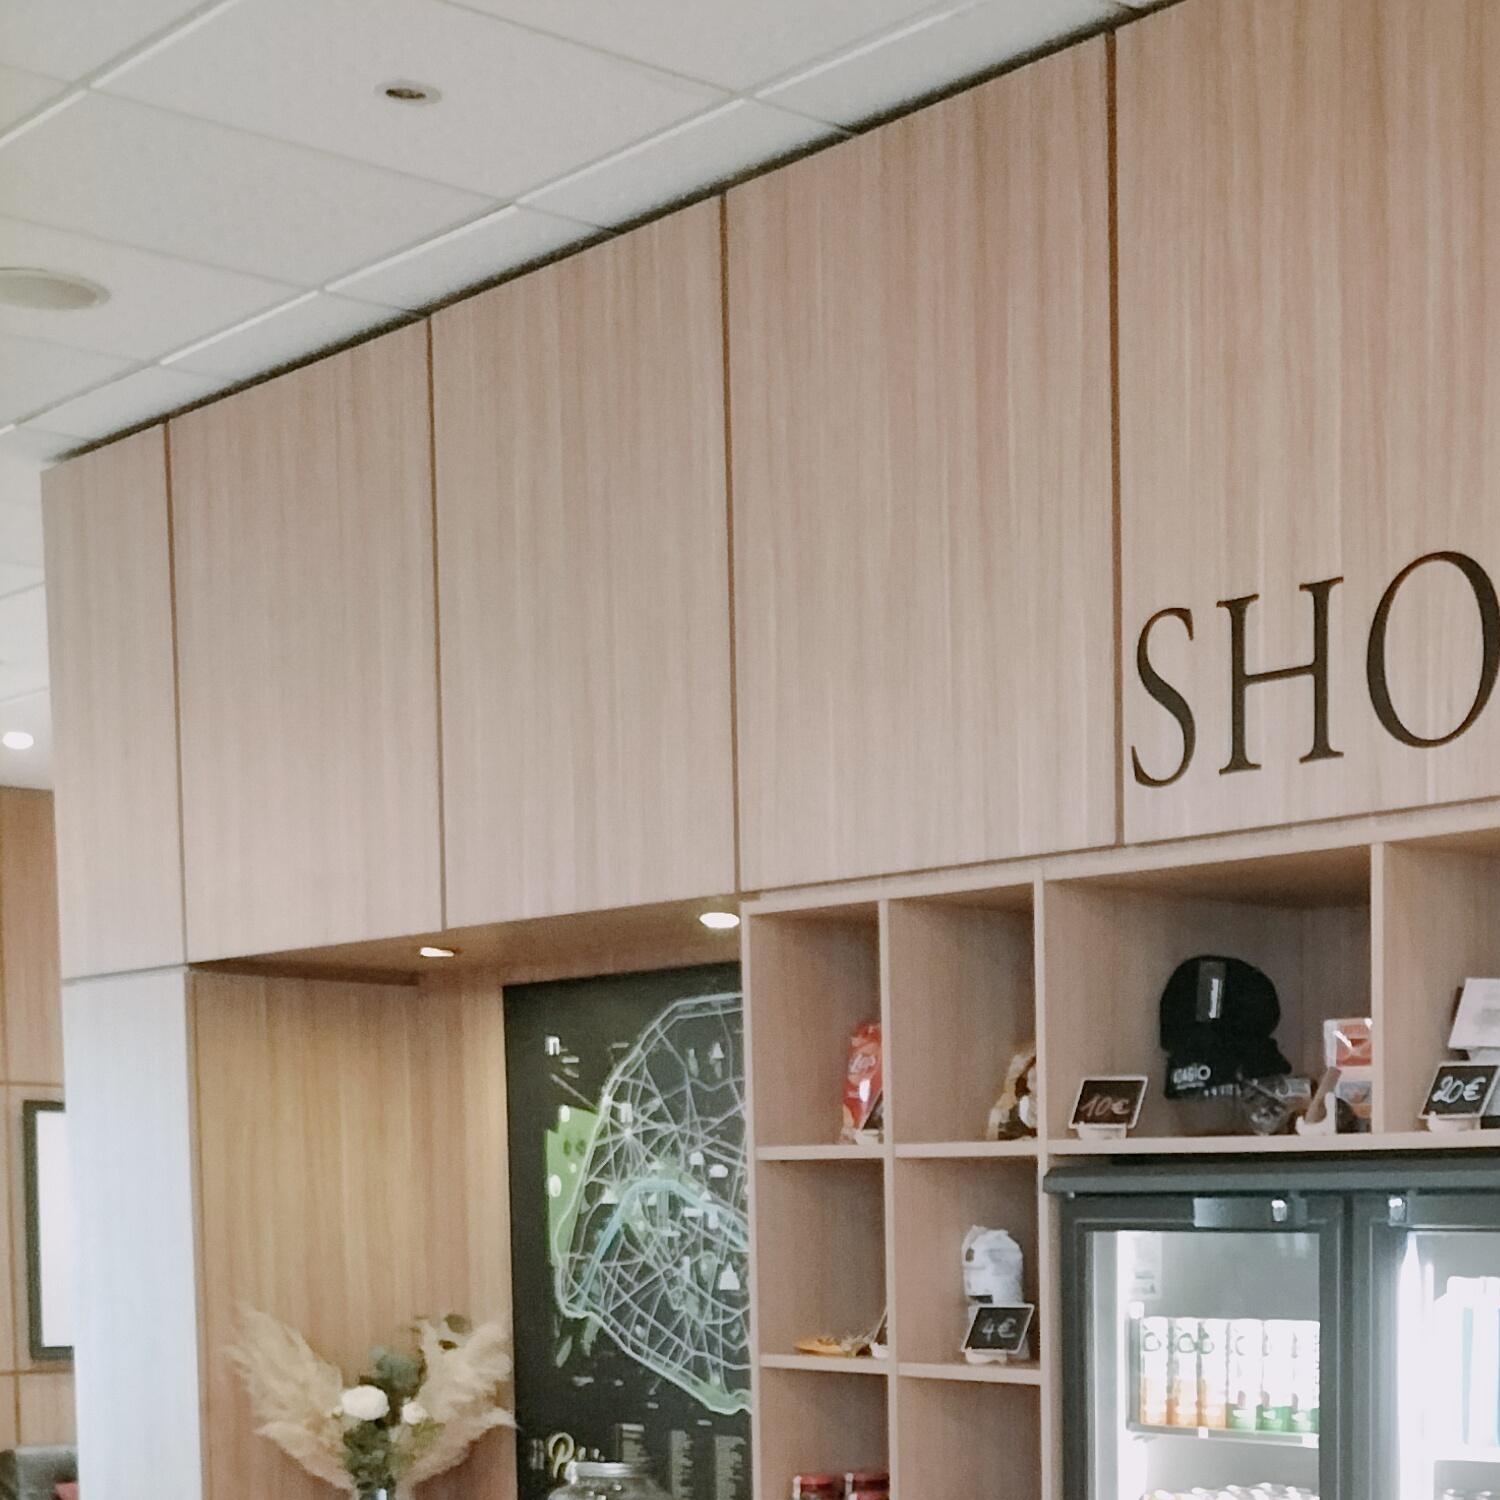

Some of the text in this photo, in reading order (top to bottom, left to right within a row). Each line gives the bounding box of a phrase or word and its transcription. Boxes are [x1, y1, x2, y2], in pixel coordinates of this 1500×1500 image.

[1432, 1074, 1487, 1104] 20€
[1080, 1094, 1130, 1118] 10€
[981, 1317, 1018, 1340] 4€
